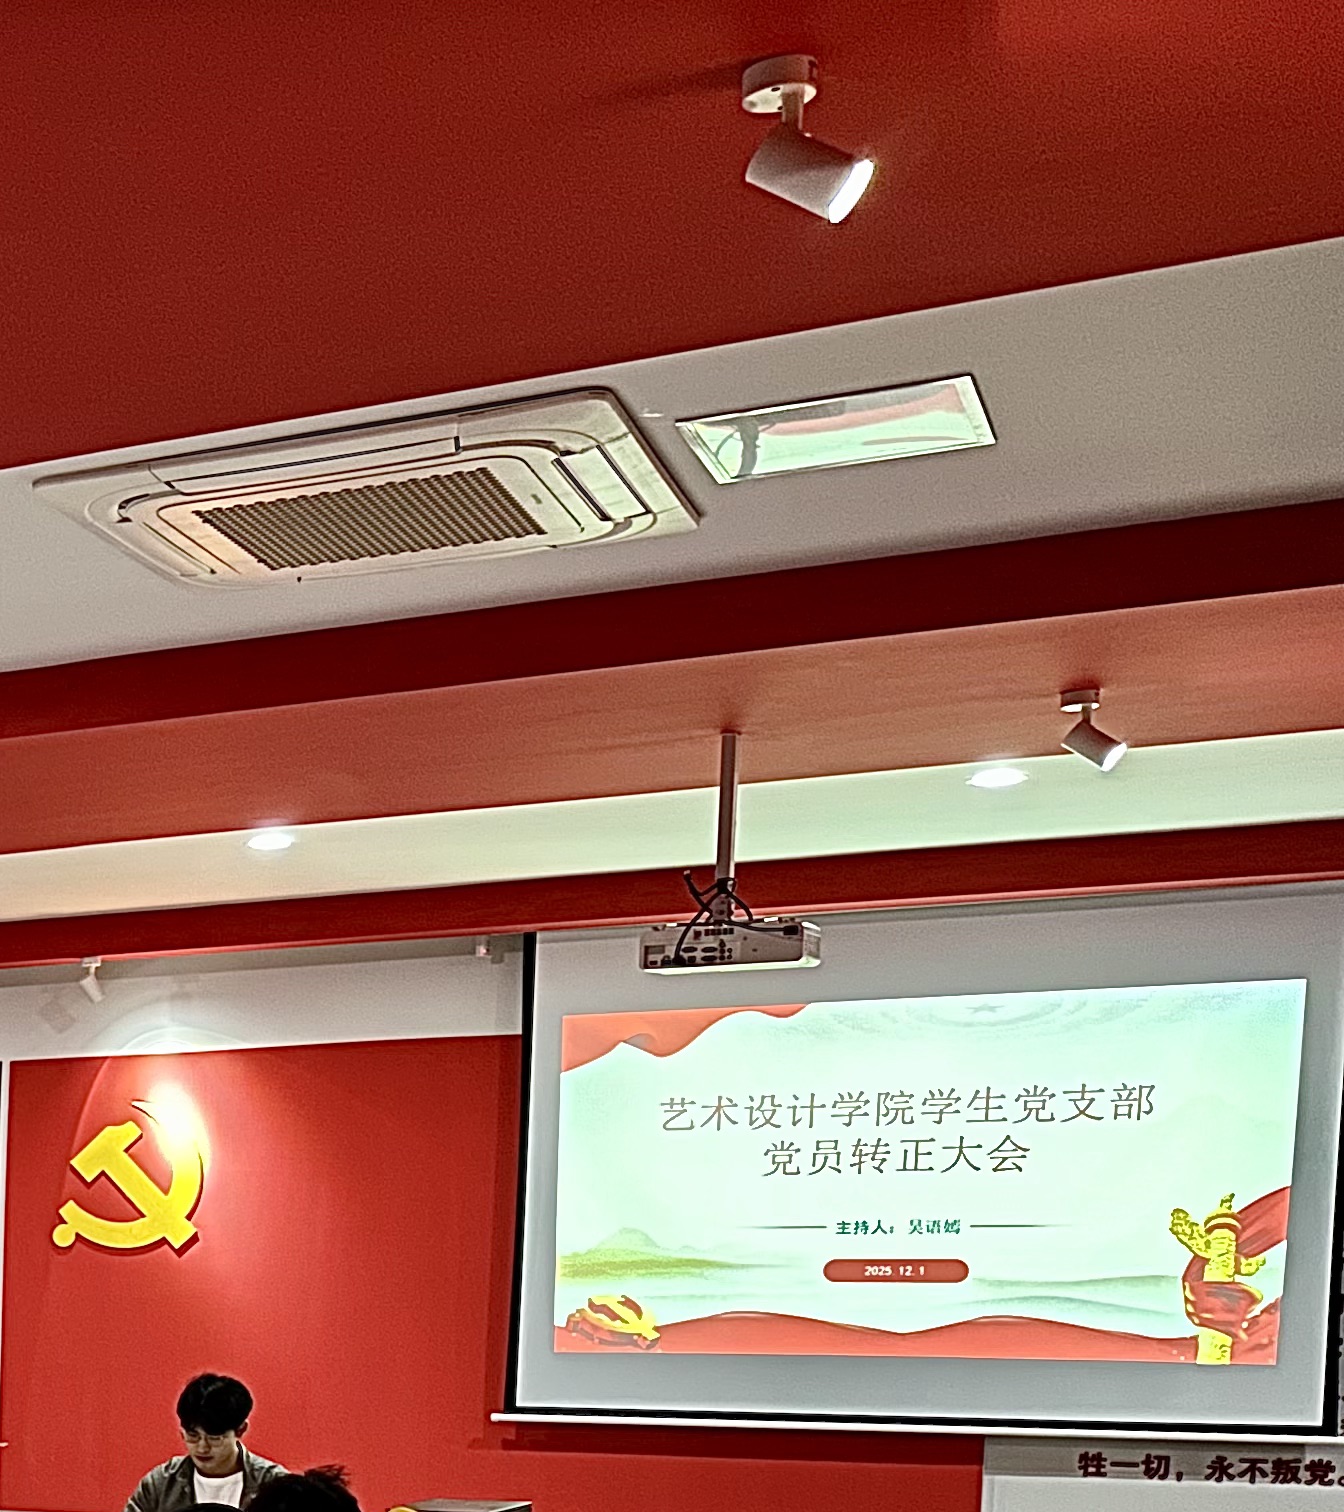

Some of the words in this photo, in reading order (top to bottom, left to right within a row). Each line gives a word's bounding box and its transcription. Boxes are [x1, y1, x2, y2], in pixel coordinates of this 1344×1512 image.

[658, 1082, 1156, 1133] 艺术设计学院学生党支部
[761, 1134, 1032, 1178] 党员转正大会
